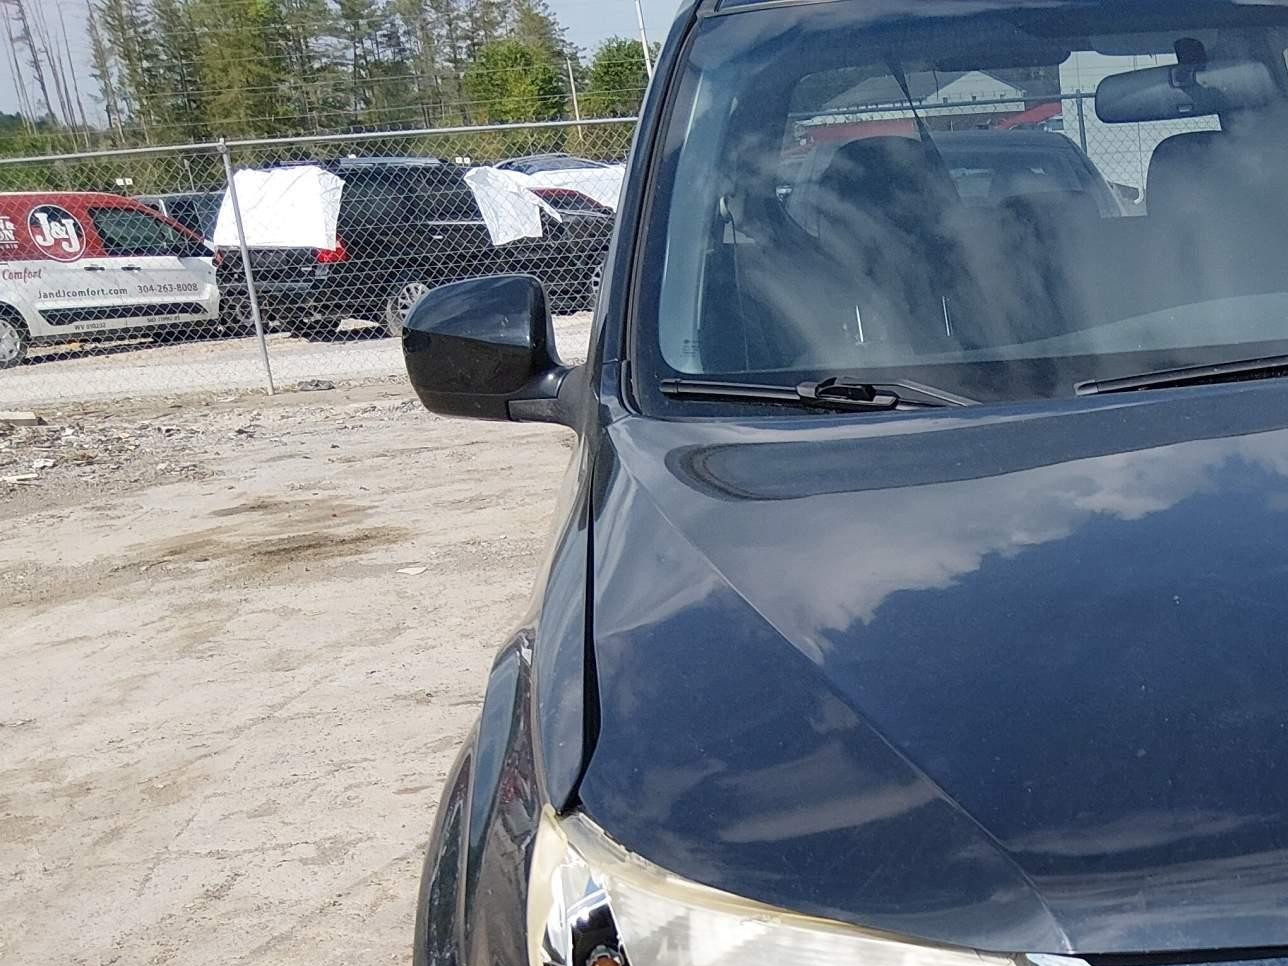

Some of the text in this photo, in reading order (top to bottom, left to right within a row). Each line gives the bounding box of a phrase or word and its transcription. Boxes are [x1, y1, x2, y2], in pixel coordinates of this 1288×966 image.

[34, 212, 81, 253] J&J
[2, 267, 42, 283] Comfort
[136, 282, 199, 294] 304-263-8008
